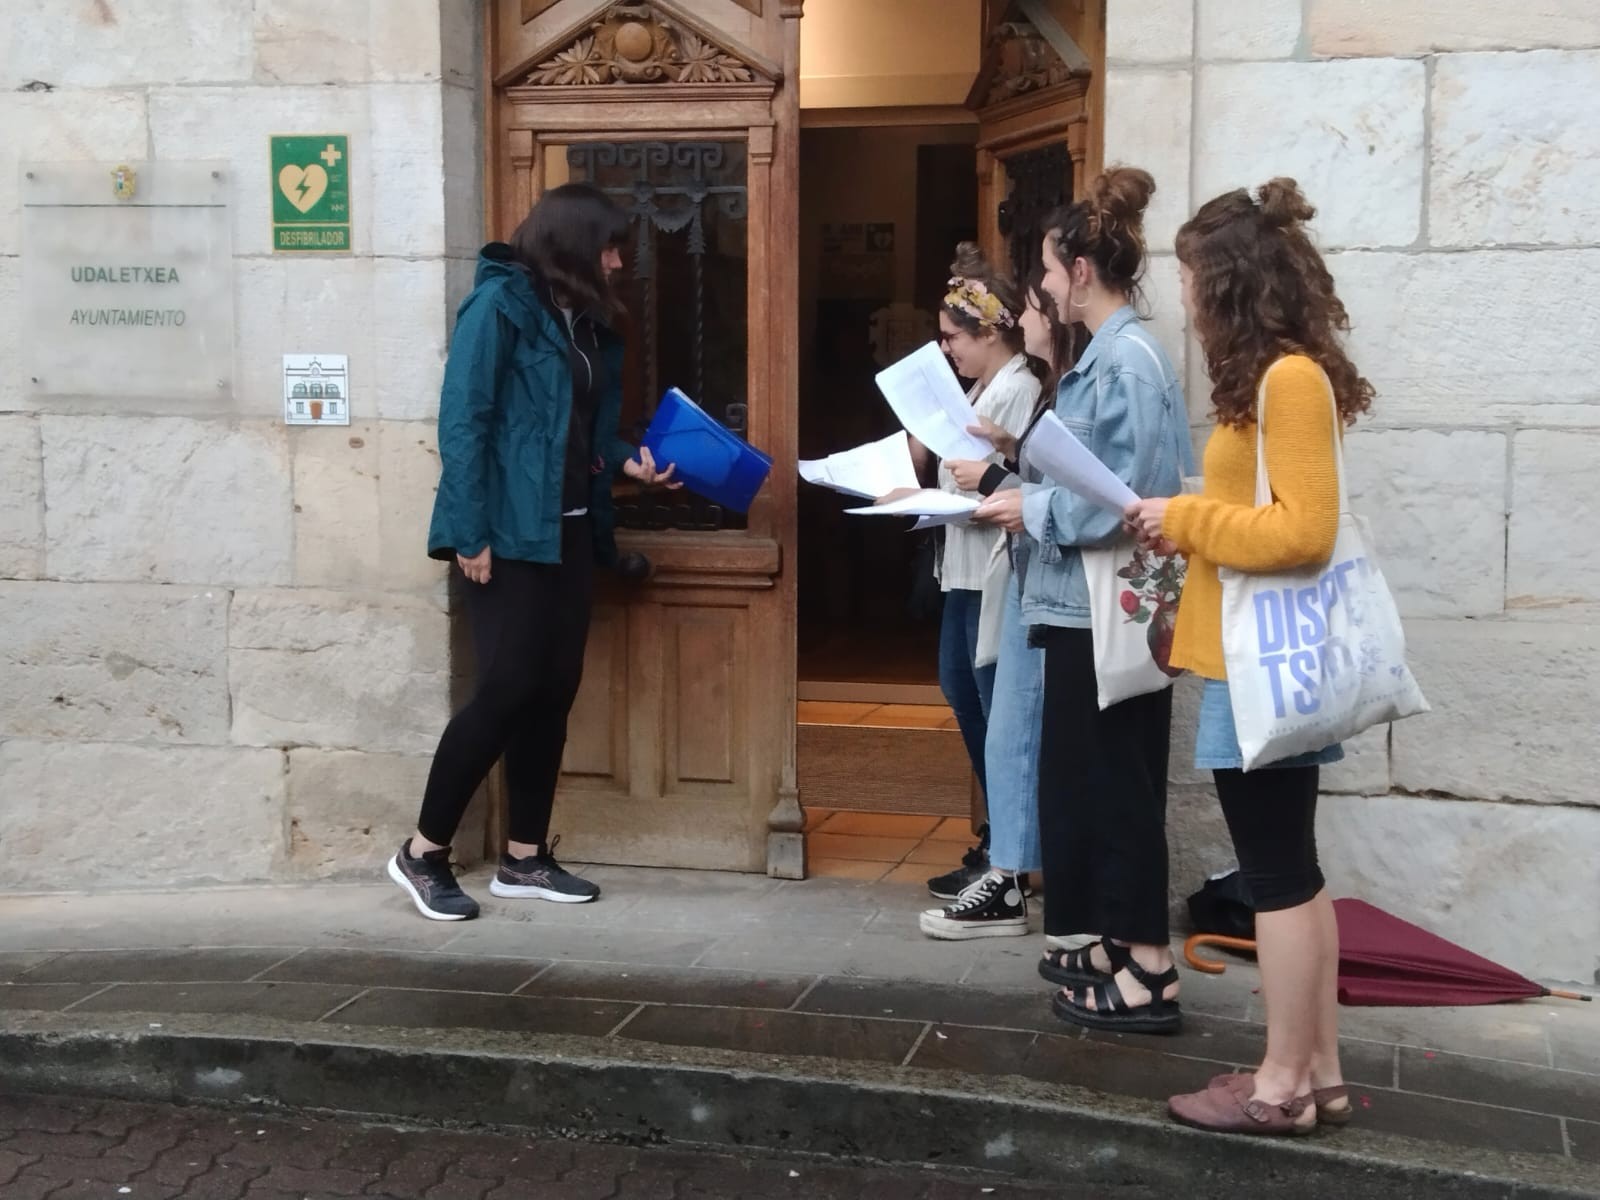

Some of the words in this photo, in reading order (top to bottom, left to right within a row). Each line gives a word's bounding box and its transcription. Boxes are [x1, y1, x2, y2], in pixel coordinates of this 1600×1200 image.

[280, 231, 344, 246] DESFIBRILADOR
[71, 266, 180, 283] UDALETXEA
[70, 309, 186, 326] AYUNTAMIENTO
